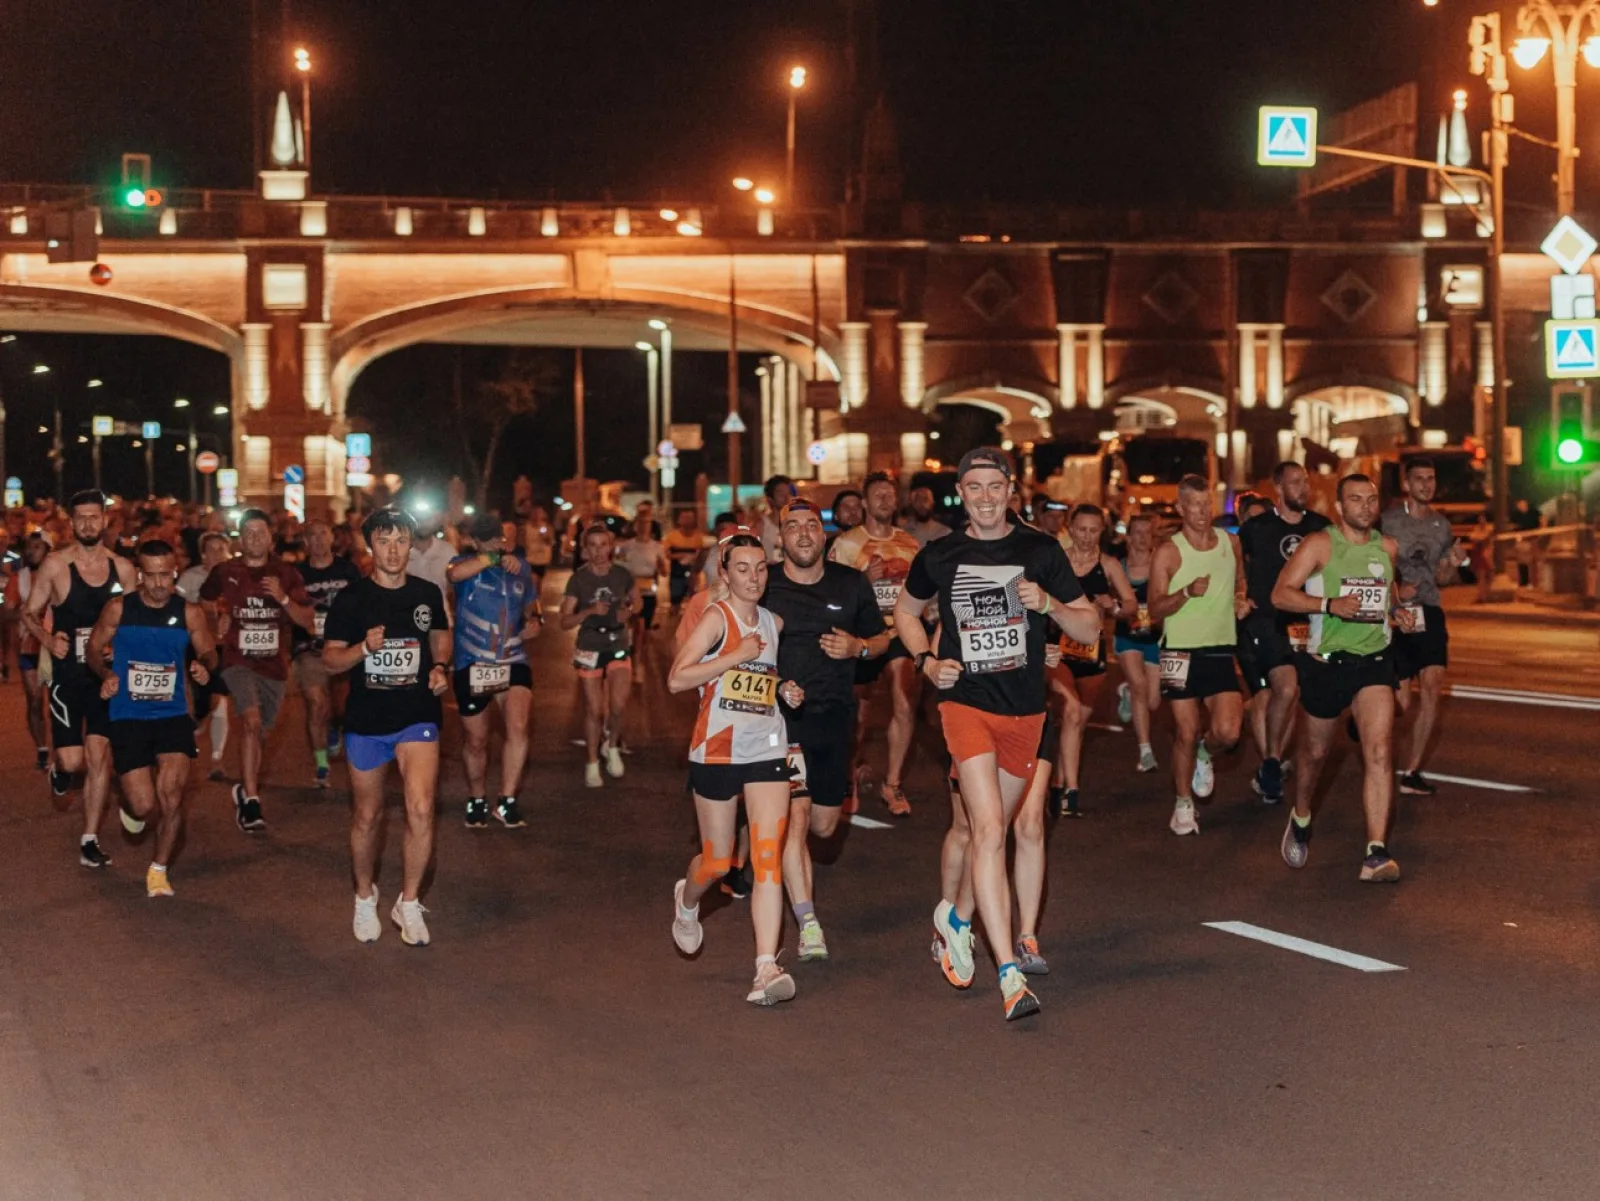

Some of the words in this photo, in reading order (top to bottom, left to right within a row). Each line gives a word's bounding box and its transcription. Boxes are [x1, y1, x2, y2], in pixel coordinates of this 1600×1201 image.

[1348, 588, 1382, 603] 395
[244, 632, 275, 644] 6868
[969, 628, 1019, 651] 5358
[372, 651, 413, 667] 5069
[970, 661, 979, 672] B
[1159, 660, 1183, 672] 707
[134, 673, 170, 688] 8755
[475, 668, 506, 680] 3619
[731, 673, 773, 697] 6147
